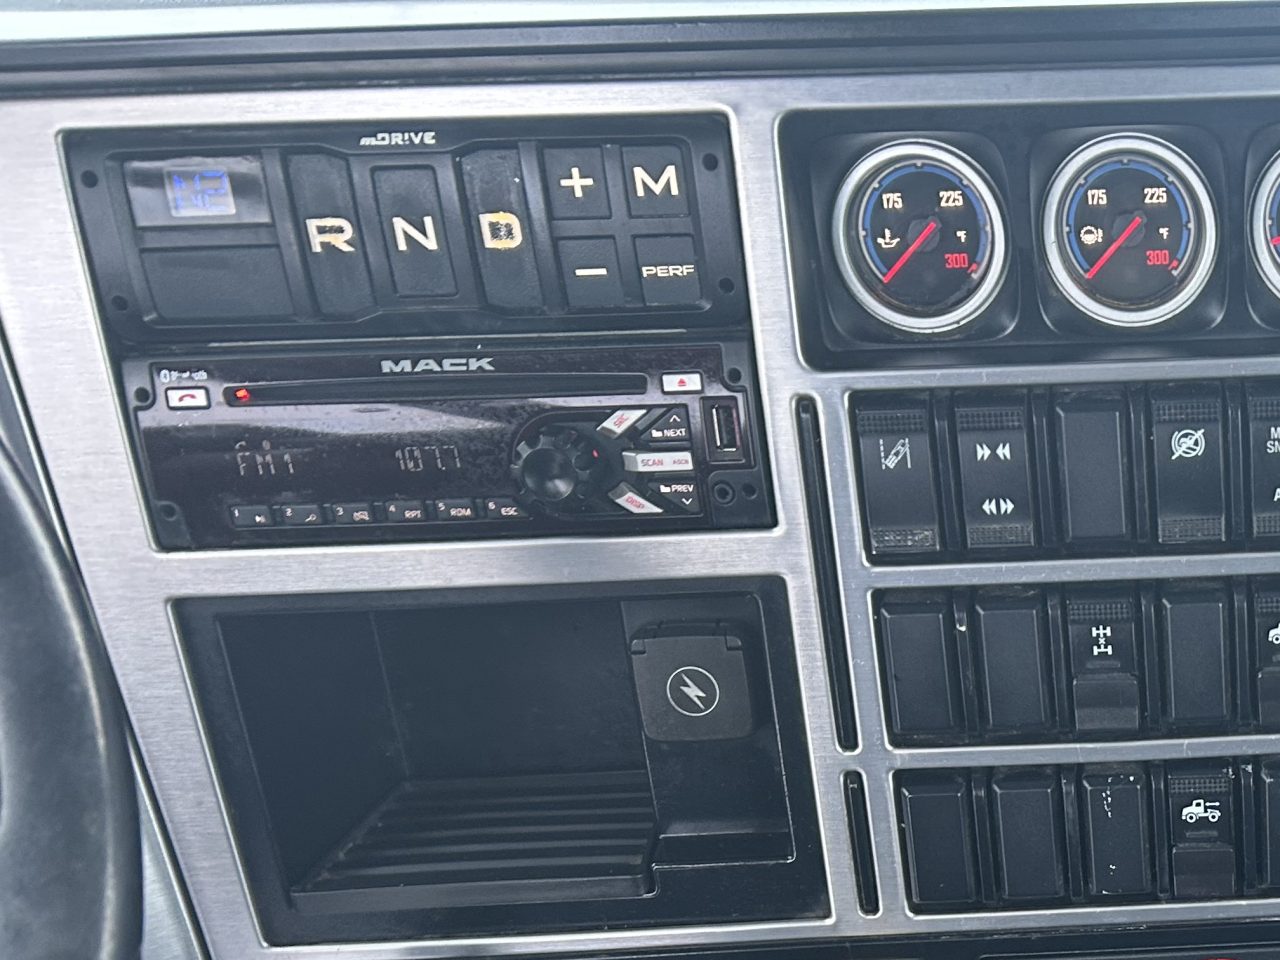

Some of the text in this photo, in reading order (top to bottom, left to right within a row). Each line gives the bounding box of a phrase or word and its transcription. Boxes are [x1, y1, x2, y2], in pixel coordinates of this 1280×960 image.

[632, 164, 679, 197] M
[881, 193, 902, 209] 175
[939, 190, 964, 207] 225
[1086, 189, 1107, 206] 175
[1143, 187, 1167, 204] 225
[305, 216, 355, 253] R
[391, 215, 438, 251] N
[478, 211, 522, 250] D
[944, 253, 969, 269] 300
[1145, 250, 1170, 265] 300
[641, 264, 695, 278] PERF
[380, 357, 496, 373] MACK
[663, 428, 686, 437] NEXT
[641, 459, 664, 467] SCAN
[671, 484, 694, 492] PREV
